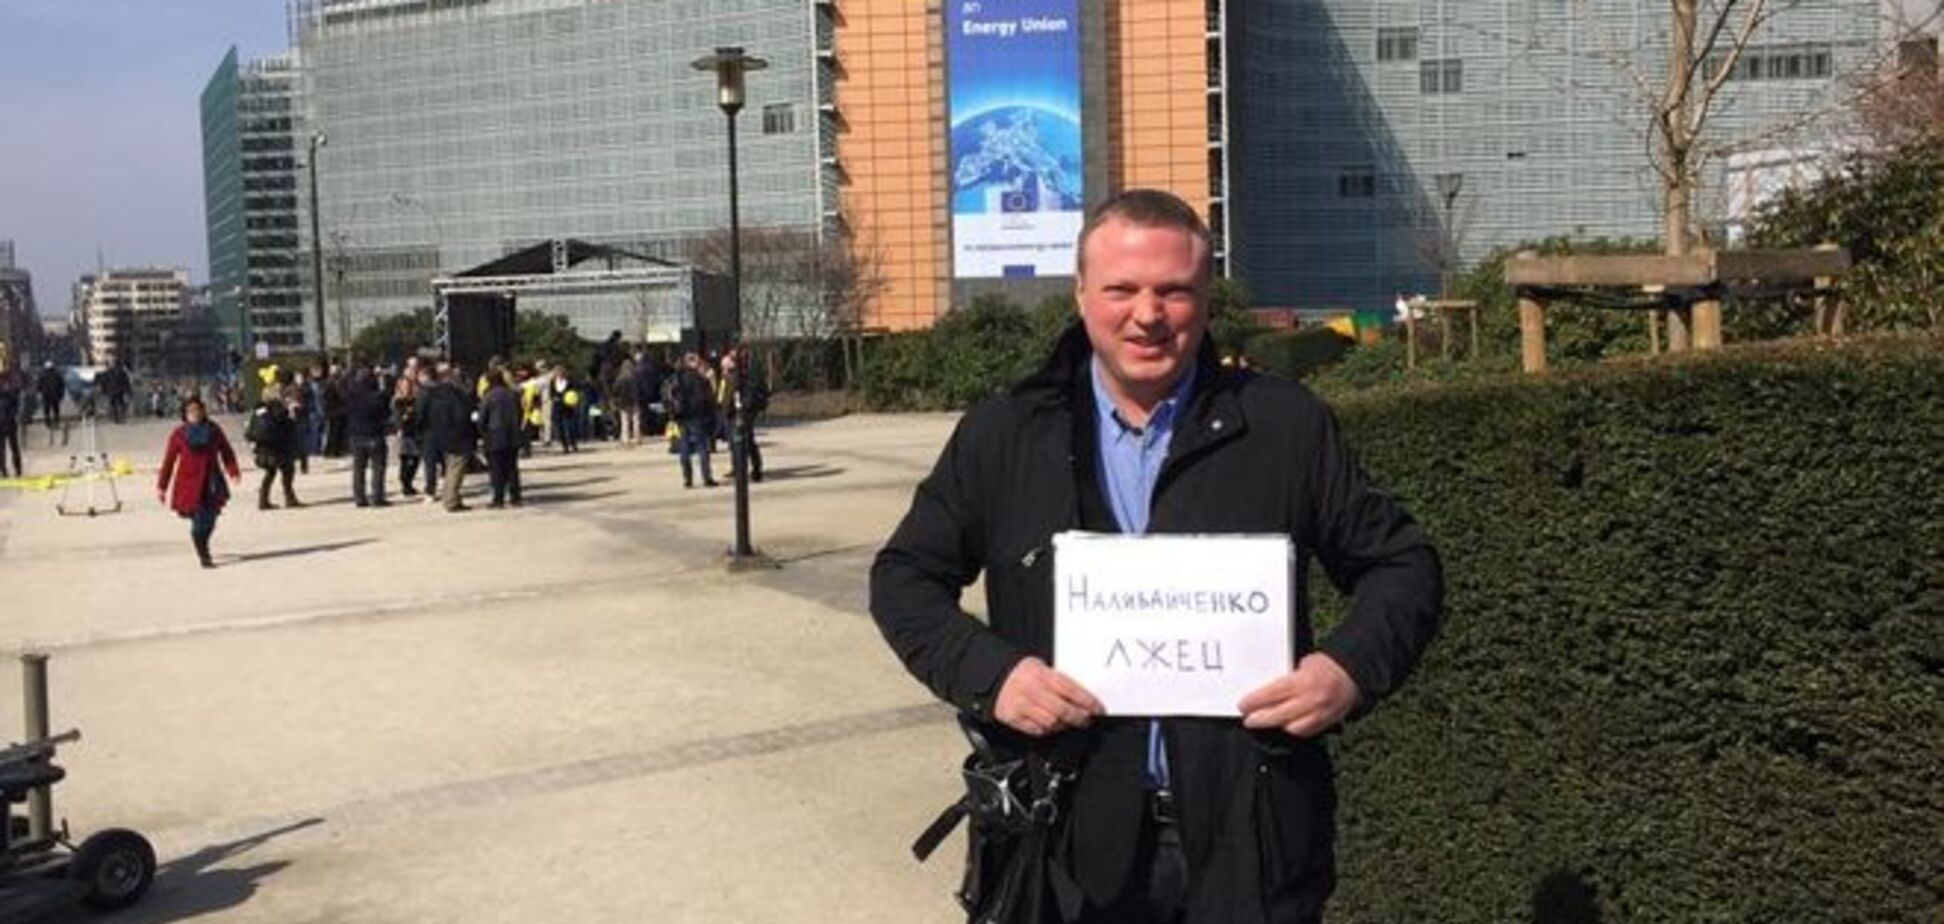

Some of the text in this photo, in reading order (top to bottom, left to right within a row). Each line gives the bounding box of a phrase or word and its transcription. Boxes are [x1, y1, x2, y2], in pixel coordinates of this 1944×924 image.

[963, 16, 1067, 36] Energy Union
[1106, 637, 1224, 673] ЛЖЕЦ
